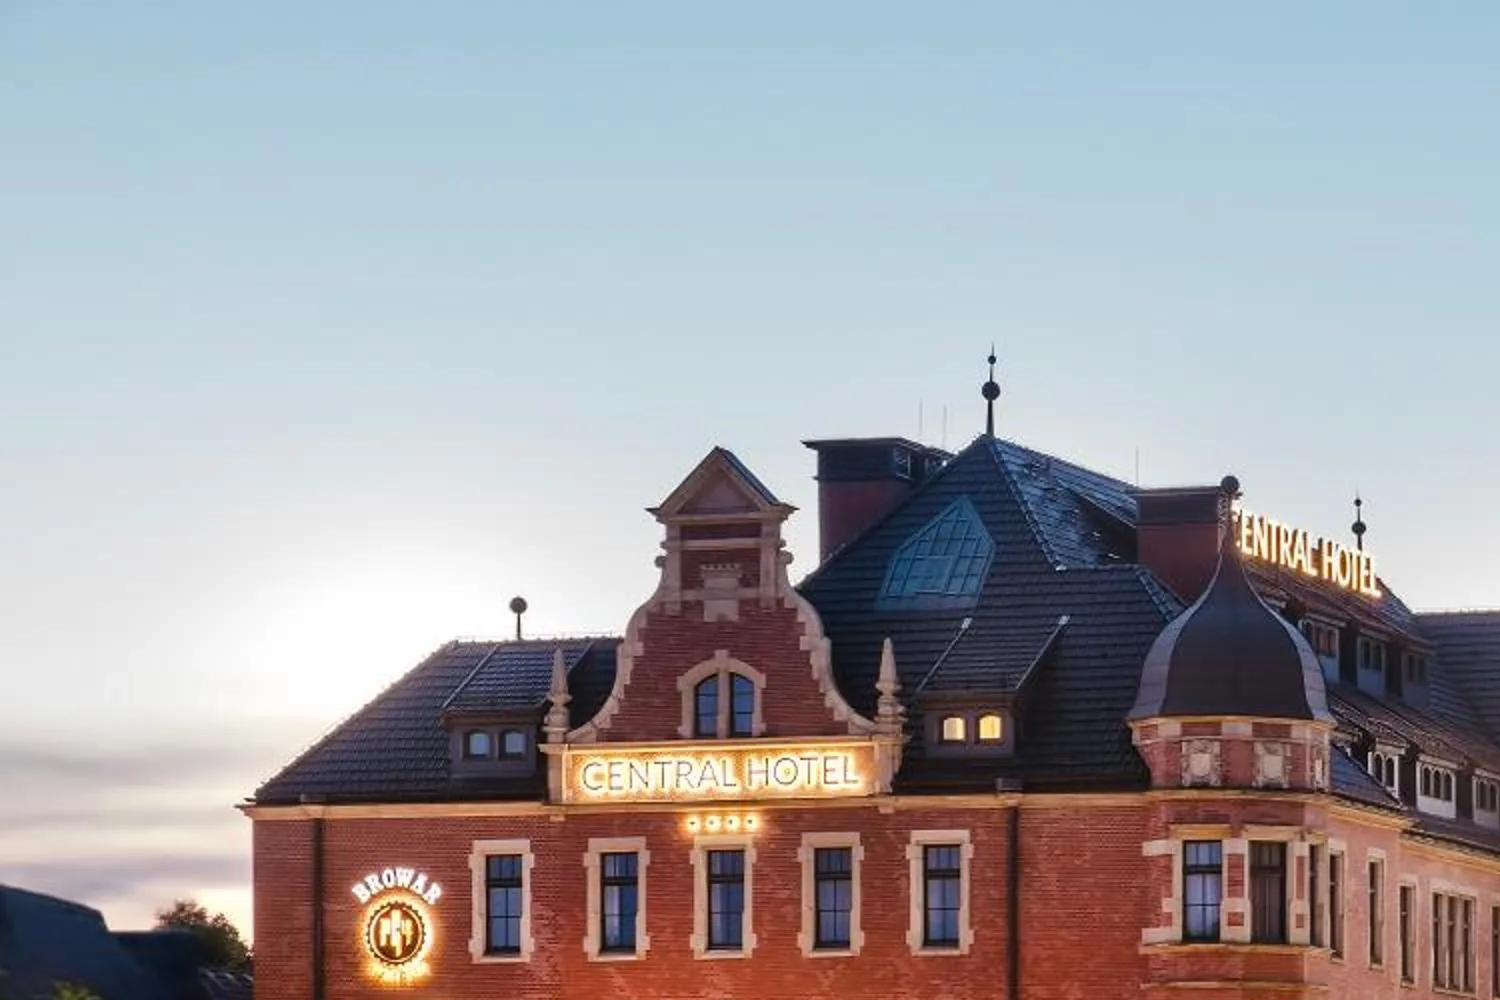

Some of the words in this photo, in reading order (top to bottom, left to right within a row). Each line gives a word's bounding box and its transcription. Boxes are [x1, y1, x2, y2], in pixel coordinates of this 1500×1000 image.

[1323, 539, 1382, 598] HOTEL
[582, 759, 737, 791] CENTRAL
[748, 755, 860, 787] HOTEL
[351, 867, 443, 905] BROWAR
